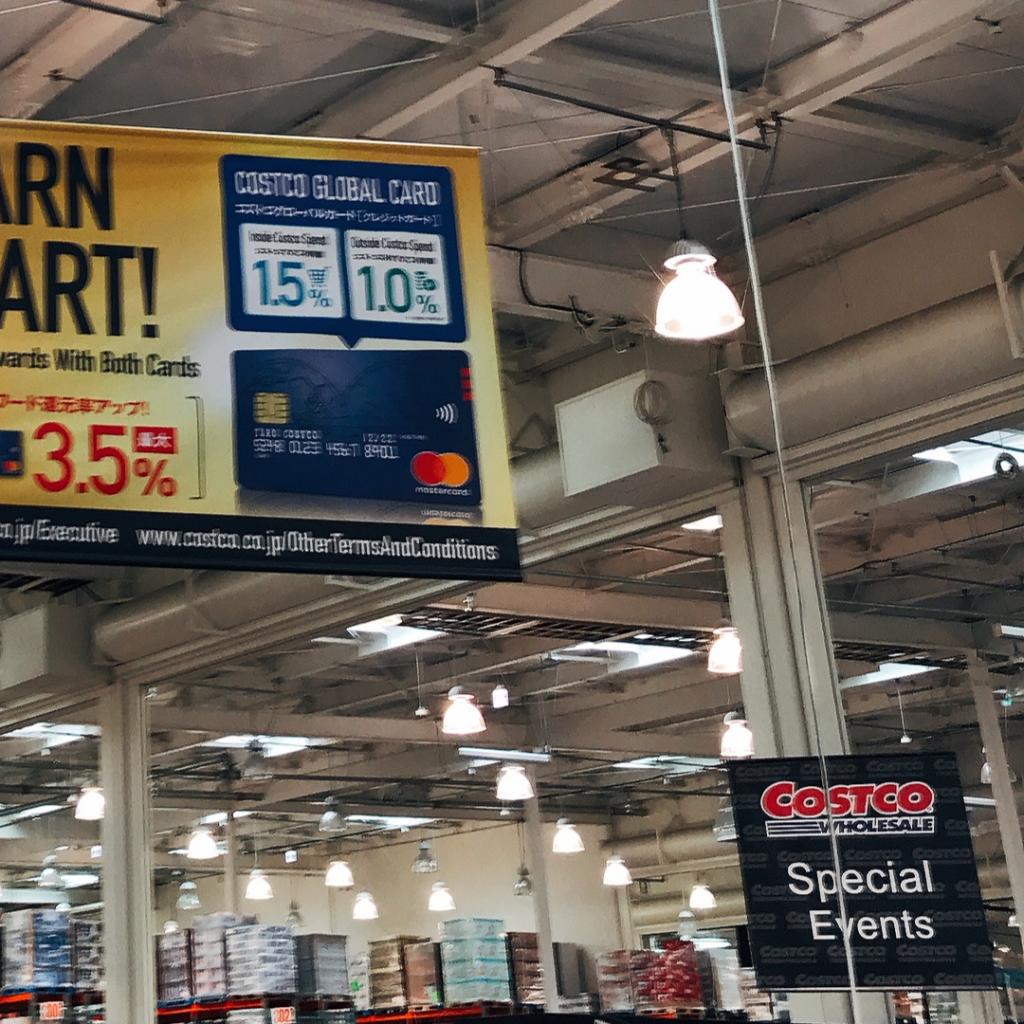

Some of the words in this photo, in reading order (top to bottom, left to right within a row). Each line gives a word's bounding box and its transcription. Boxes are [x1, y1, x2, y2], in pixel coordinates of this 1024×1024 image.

[234, 171, 309, 197] COSTCO
[312, 175, 385, 203] GLOBAL
[388, 179, 441, 206] CARD
[53, 347, 96, 372] With
[99, 350, 144, 375] Both
[146, 353, 201, 378] Cards
[135, 528, 500, 561] www.costco.co.jp/OtherTermsAndConditions
[760, 780, 935, 818] COSTCO
[818, 818, 934, 833] WHOLESALE
[787, 860, 935, 903] Special
[808, 909, 936, 941] Events
